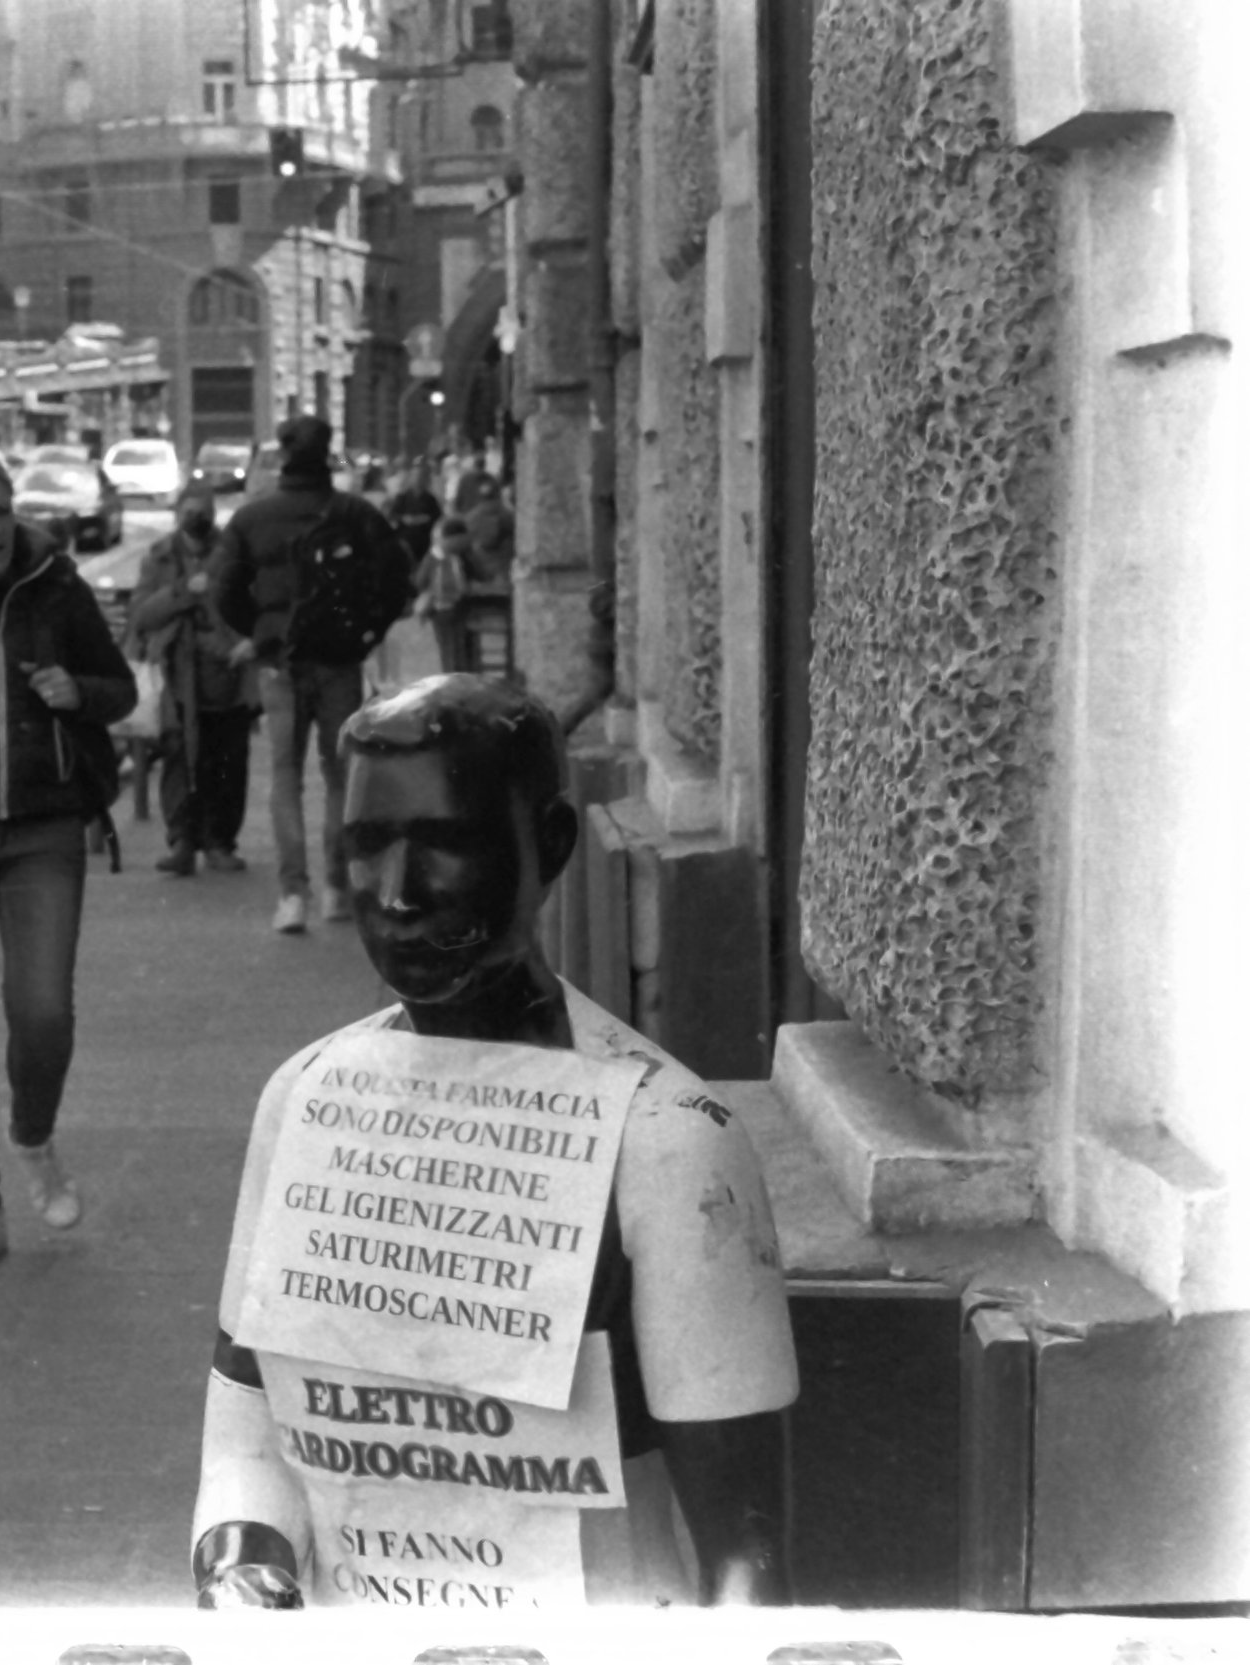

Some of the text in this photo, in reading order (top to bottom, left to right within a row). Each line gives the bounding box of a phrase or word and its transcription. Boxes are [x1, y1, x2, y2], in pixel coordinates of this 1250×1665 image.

[320, 1066, 350, 1088] IN
[444, 1082, 602, 1120] FARMACIA
[301, 1098, 599, 1163] SONO DISPONIBILI
[328, 1145, 550, 1202] MASCHERINE
[284, 1182, 584, 1253] GEL IGIENIZZANTI
[305, 1228, 534, 1292] SATURIMETRI
[280, 1267, 552, 1342] TERMOSCANNER
[302, 1377, 515, 1438] ELETTRO
[339, 1523, 504, 1568] SI FANNO
